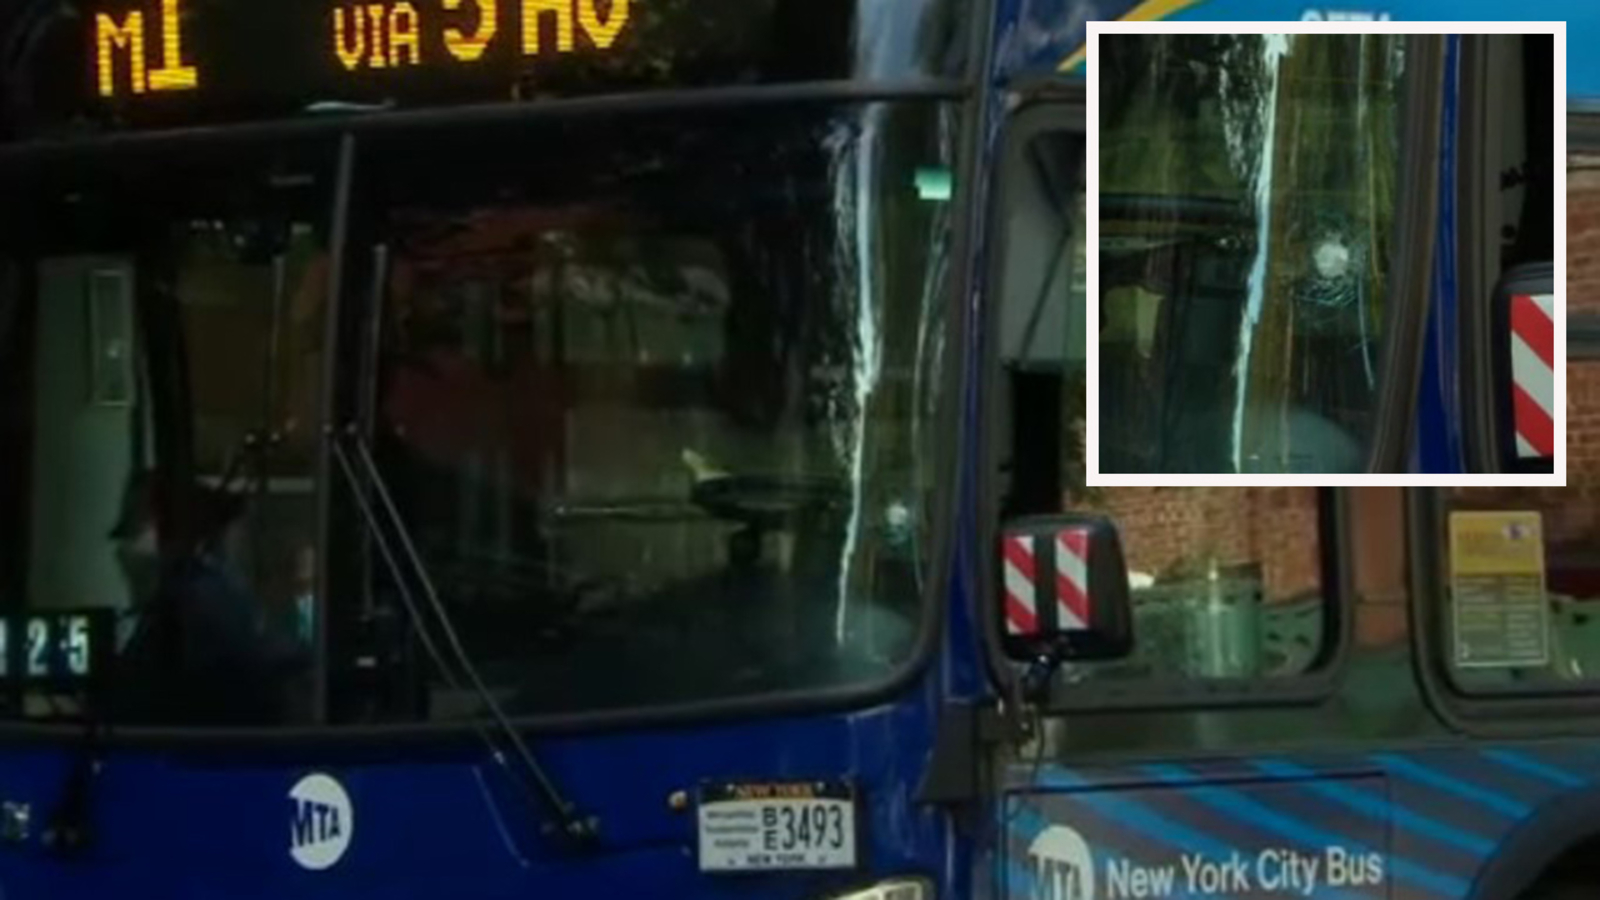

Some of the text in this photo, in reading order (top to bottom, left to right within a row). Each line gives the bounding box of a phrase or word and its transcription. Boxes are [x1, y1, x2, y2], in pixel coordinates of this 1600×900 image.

[334, 4, 420, 70] VIA
[287, 797, 342, 848] MTA
[781, 803, 844, 851] 3493
[1107, 845, 1384, 899] New York City Bus
